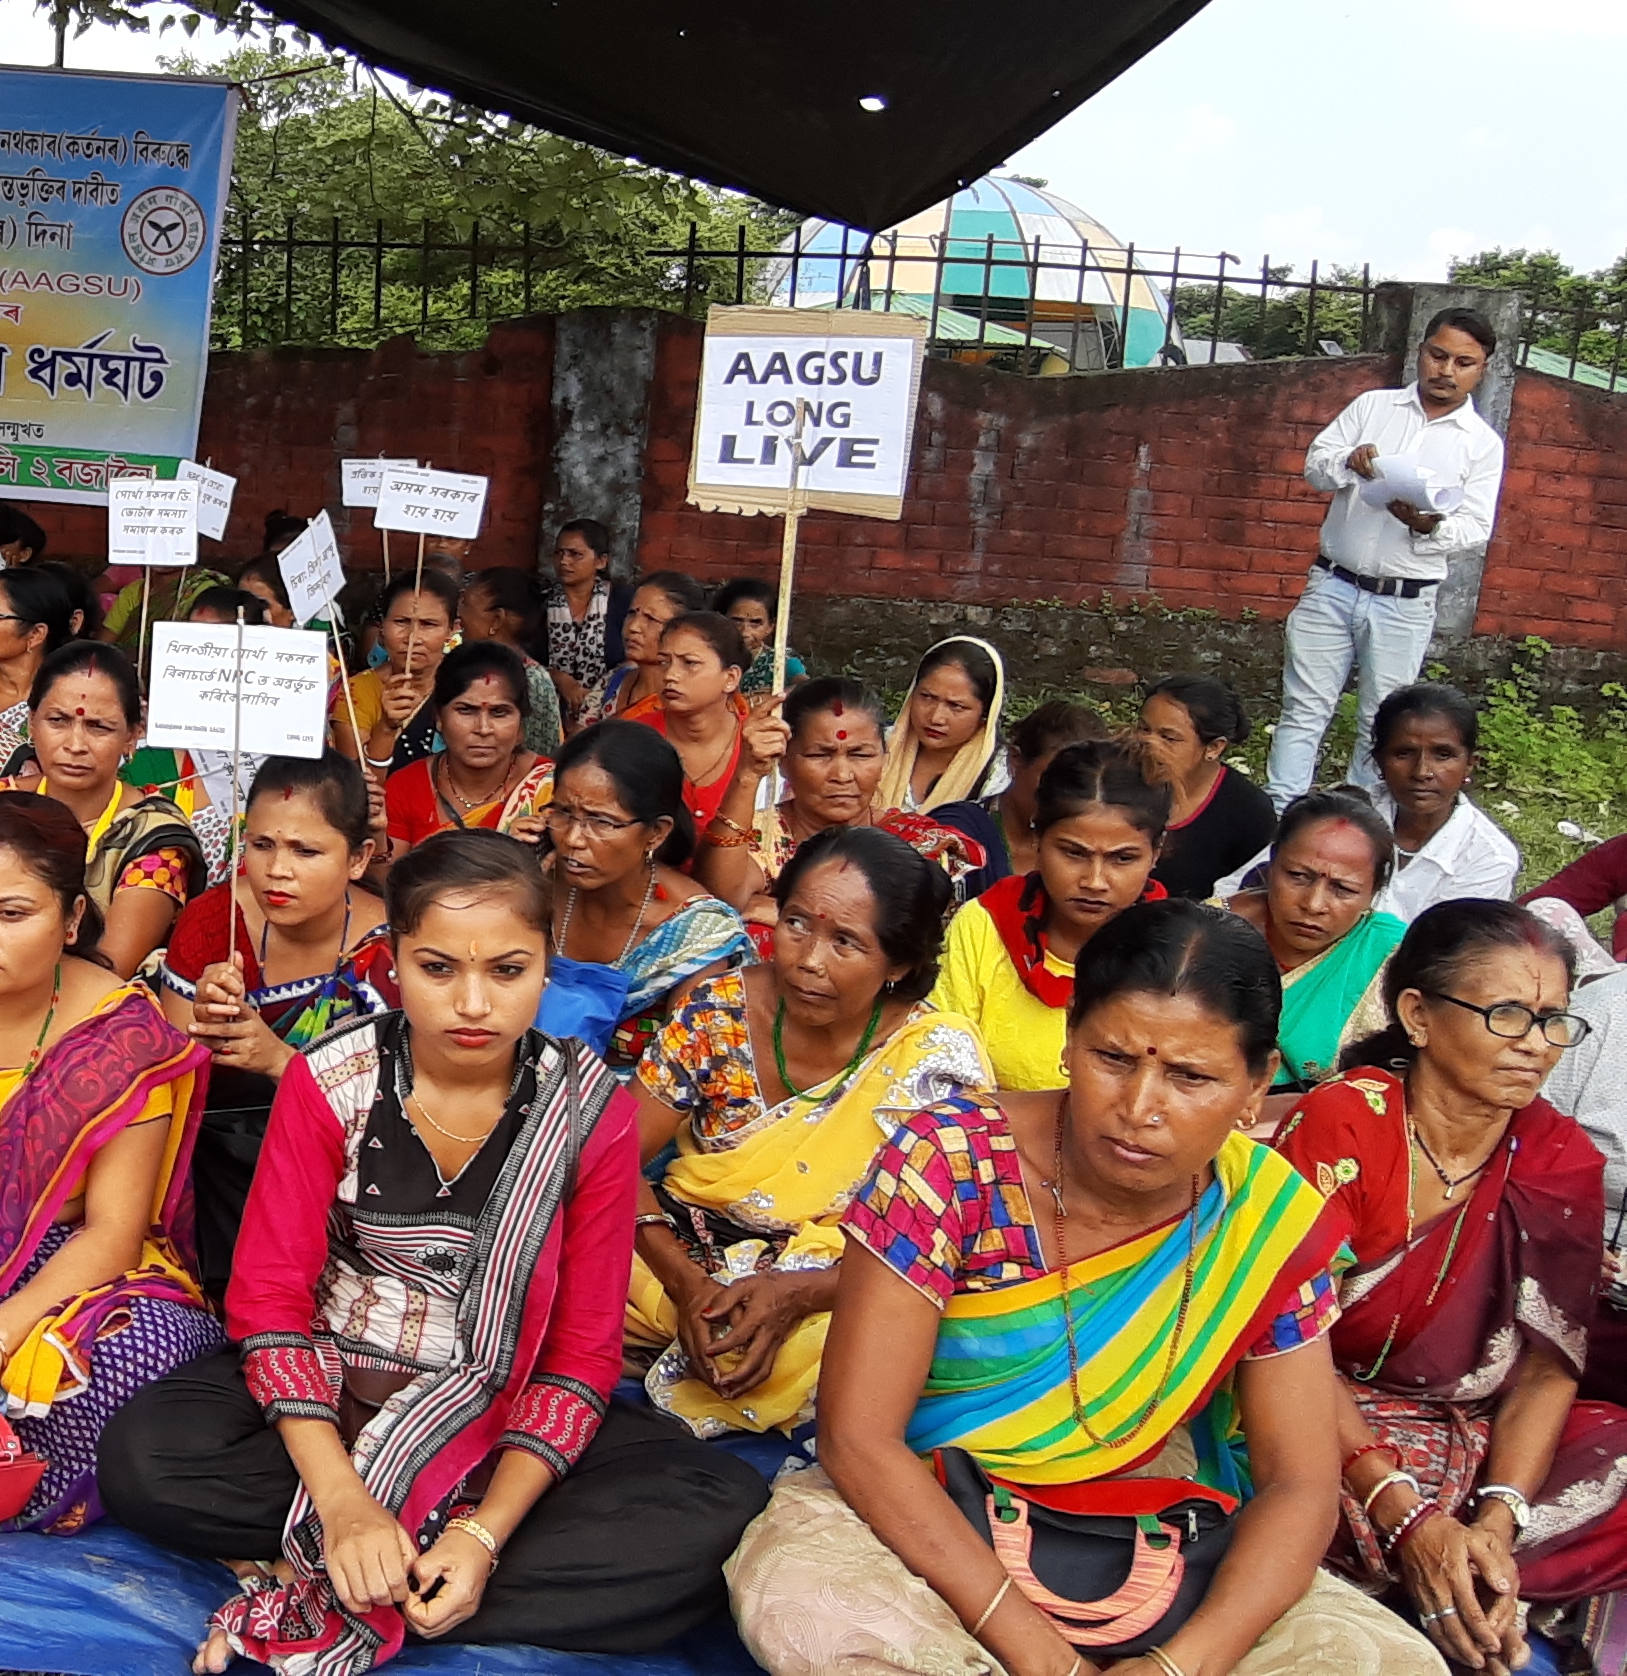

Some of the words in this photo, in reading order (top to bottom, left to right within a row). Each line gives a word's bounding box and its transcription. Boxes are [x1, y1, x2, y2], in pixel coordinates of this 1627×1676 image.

[133, 129, 191, 170] বিৰুদ্ধে
[70, 171, 120, 207] দাবীত
[25, 211, 73, 251] দিনা
[25, 328, 172, 407] ধৰ্মঘট
[722, 351, 883, 387] AAGSU
[744, 400, 851, 428] LONG
[717, 434, 880, 469] LIVE
[31, 456, 51, 487] ২
[390, 480, 425, 496] অসম
[429, 486, 480, 504] সৰকাৰ
[402, 504, 430, 518] হায়
[432, 508, 459, 523] হায়
[257, 675, 271, 686] ত
